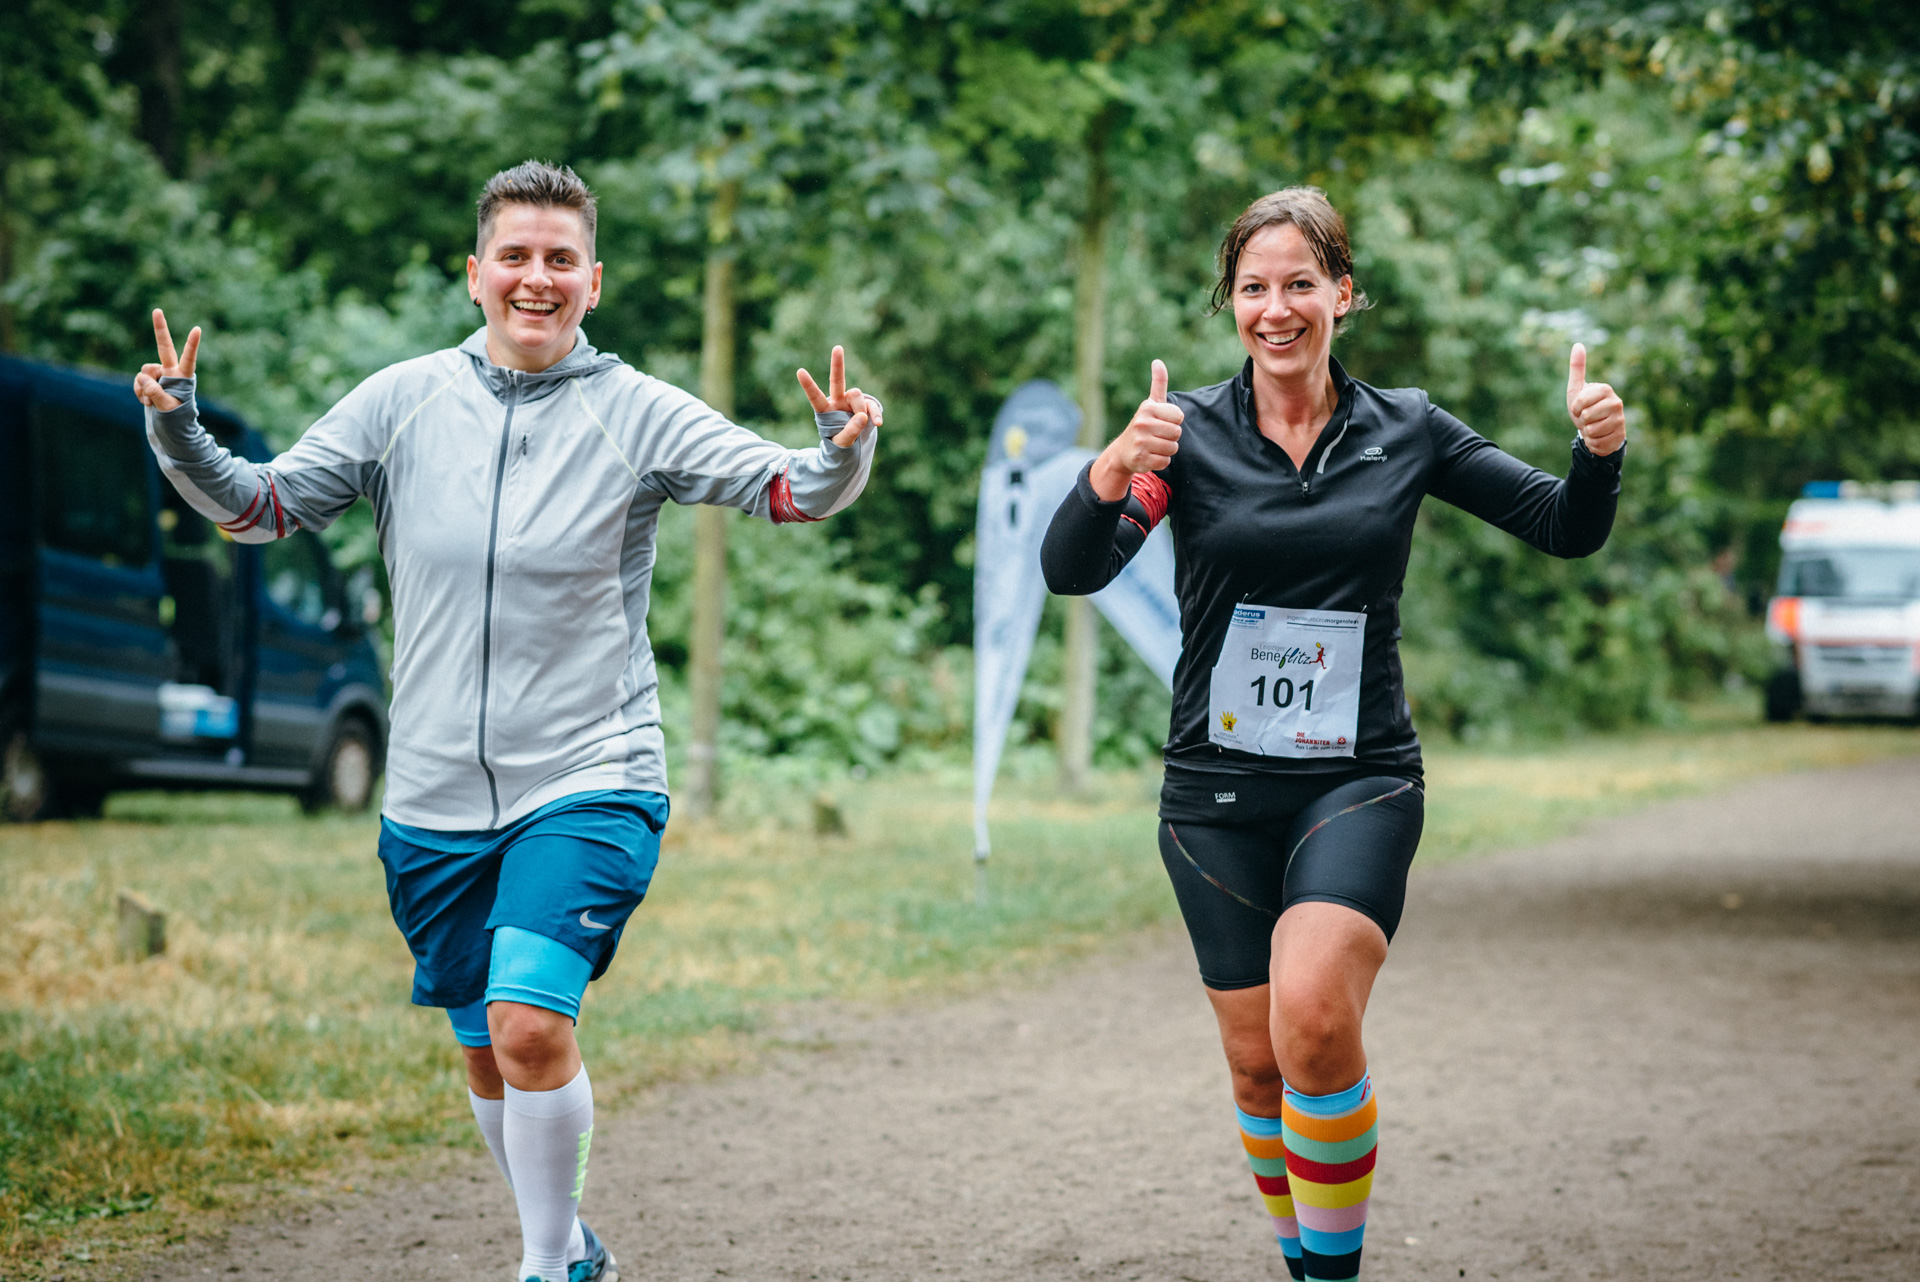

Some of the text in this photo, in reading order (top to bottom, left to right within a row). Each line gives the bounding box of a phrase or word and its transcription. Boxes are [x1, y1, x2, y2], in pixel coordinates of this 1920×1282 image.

[1287, 615, 1358, 624] ingenieurbüromorgensten
[1259, 643, 1285, 651] Leipziger
[1250, 675, 1314, 711] 101
